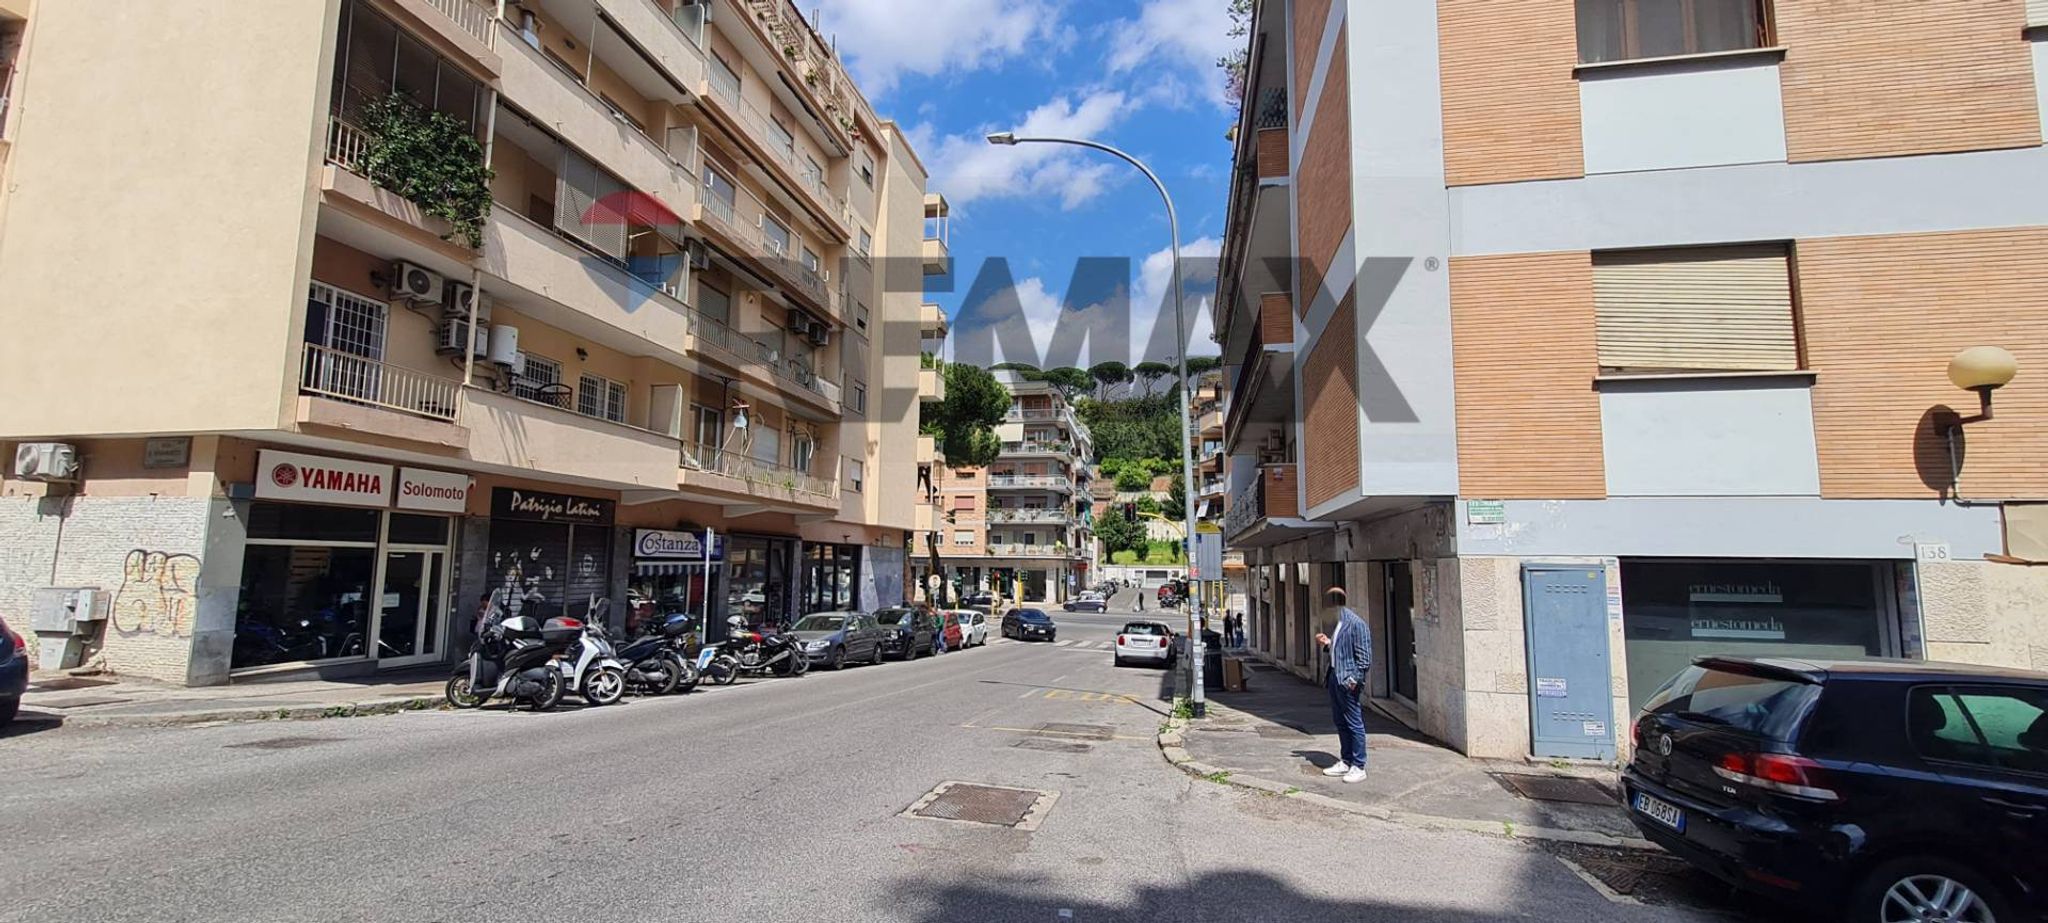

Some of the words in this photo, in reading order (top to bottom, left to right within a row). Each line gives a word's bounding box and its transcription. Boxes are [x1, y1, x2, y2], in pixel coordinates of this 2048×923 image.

[301, 466, 381, 494] YAMAHA
[402, 481, 465, 500] Solomoto
[510, 490, 563, 519] Patrizio
[565, 497, 601, 517] Latini
[638, 531, 700, 556] Costanza
[1638, 793, 1650, 811] EB
